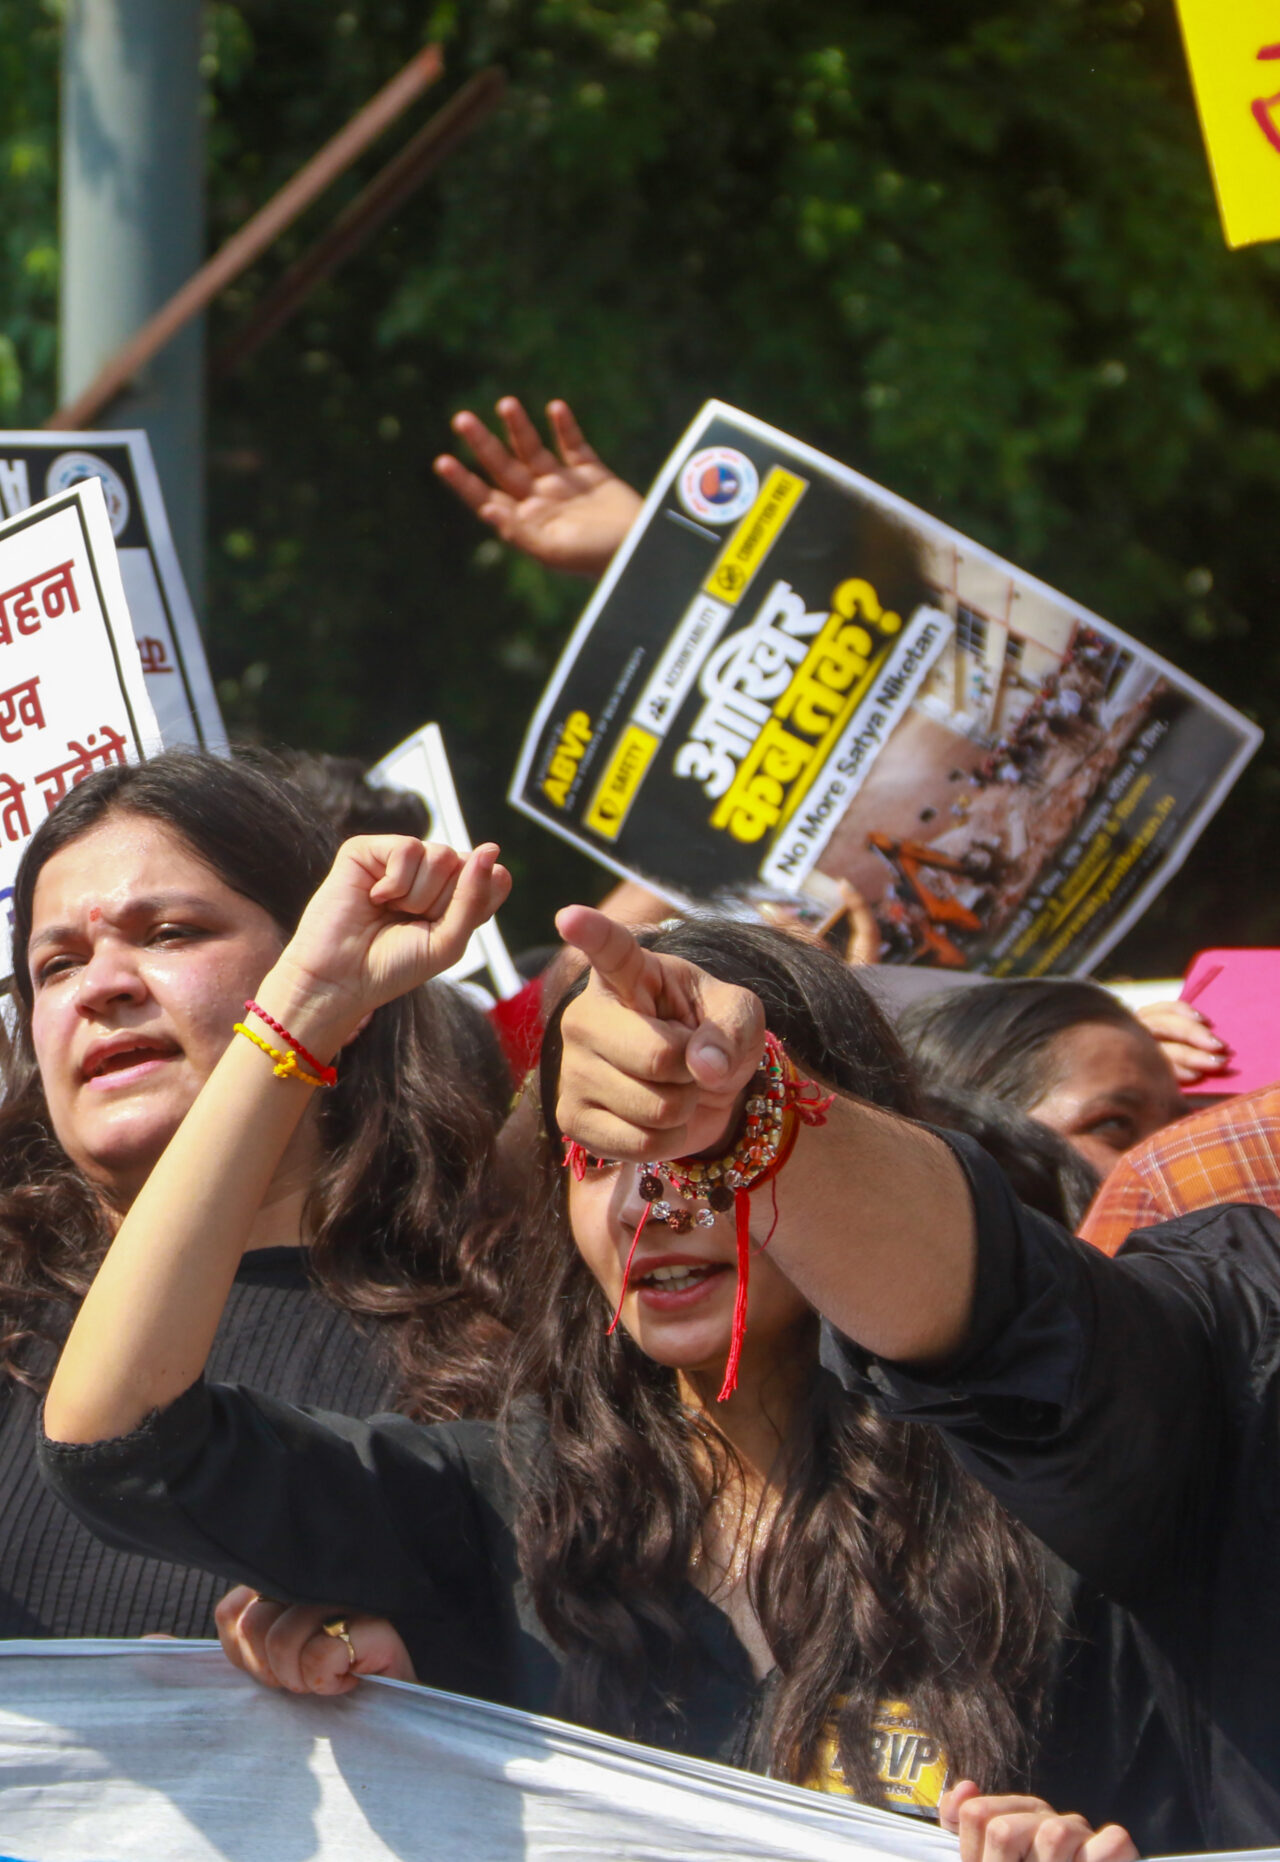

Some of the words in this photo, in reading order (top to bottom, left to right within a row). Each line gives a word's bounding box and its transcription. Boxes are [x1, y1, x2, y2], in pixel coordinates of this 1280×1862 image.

[541, 710, 592, 808] ABVP
[611, 741, 645, 795] SAFETY
[710, 716, 819, 842] कब
[777, 843, 808, 875] No
[798, 780, 846, 843] More
[837, 711, 887, 778] Satya
[875, 622, 941, 713] Niketan
